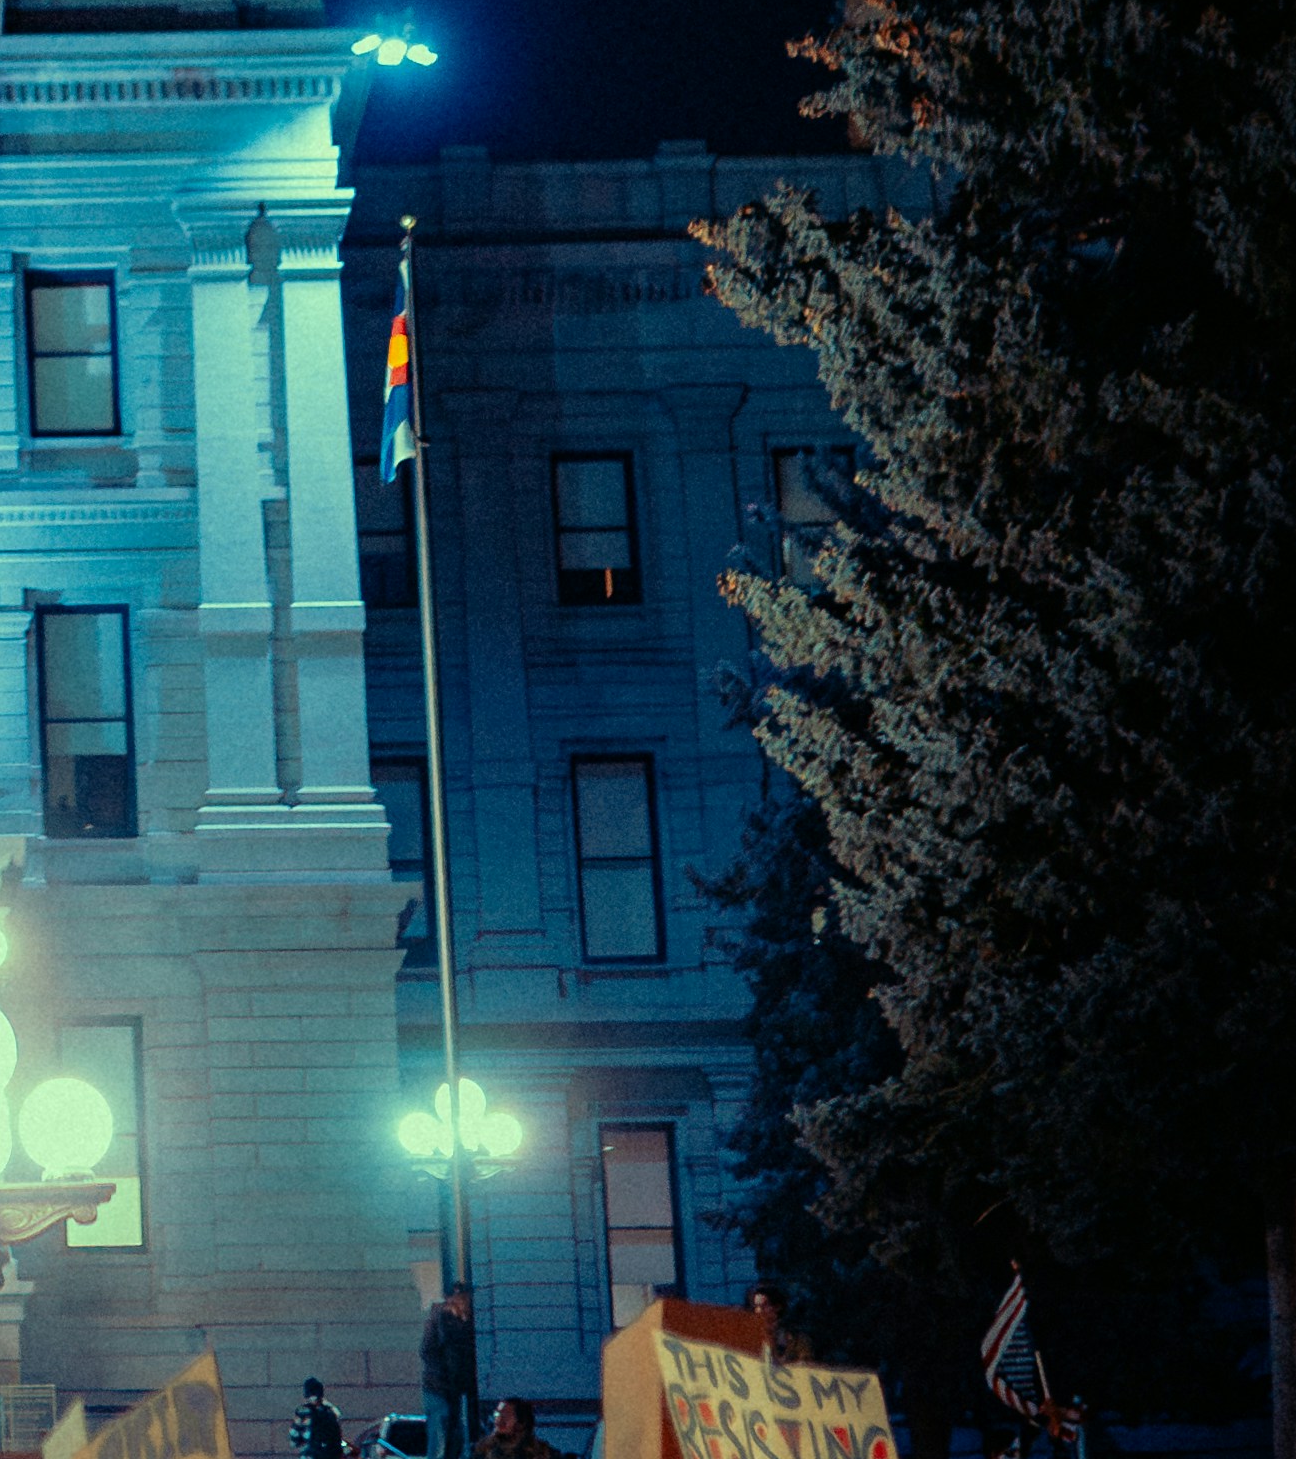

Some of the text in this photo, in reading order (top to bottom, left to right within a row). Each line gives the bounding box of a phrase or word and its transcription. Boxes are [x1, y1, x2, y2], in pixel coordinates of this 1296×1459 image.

[663, 1337, 870, 1414] THIS IS MY
